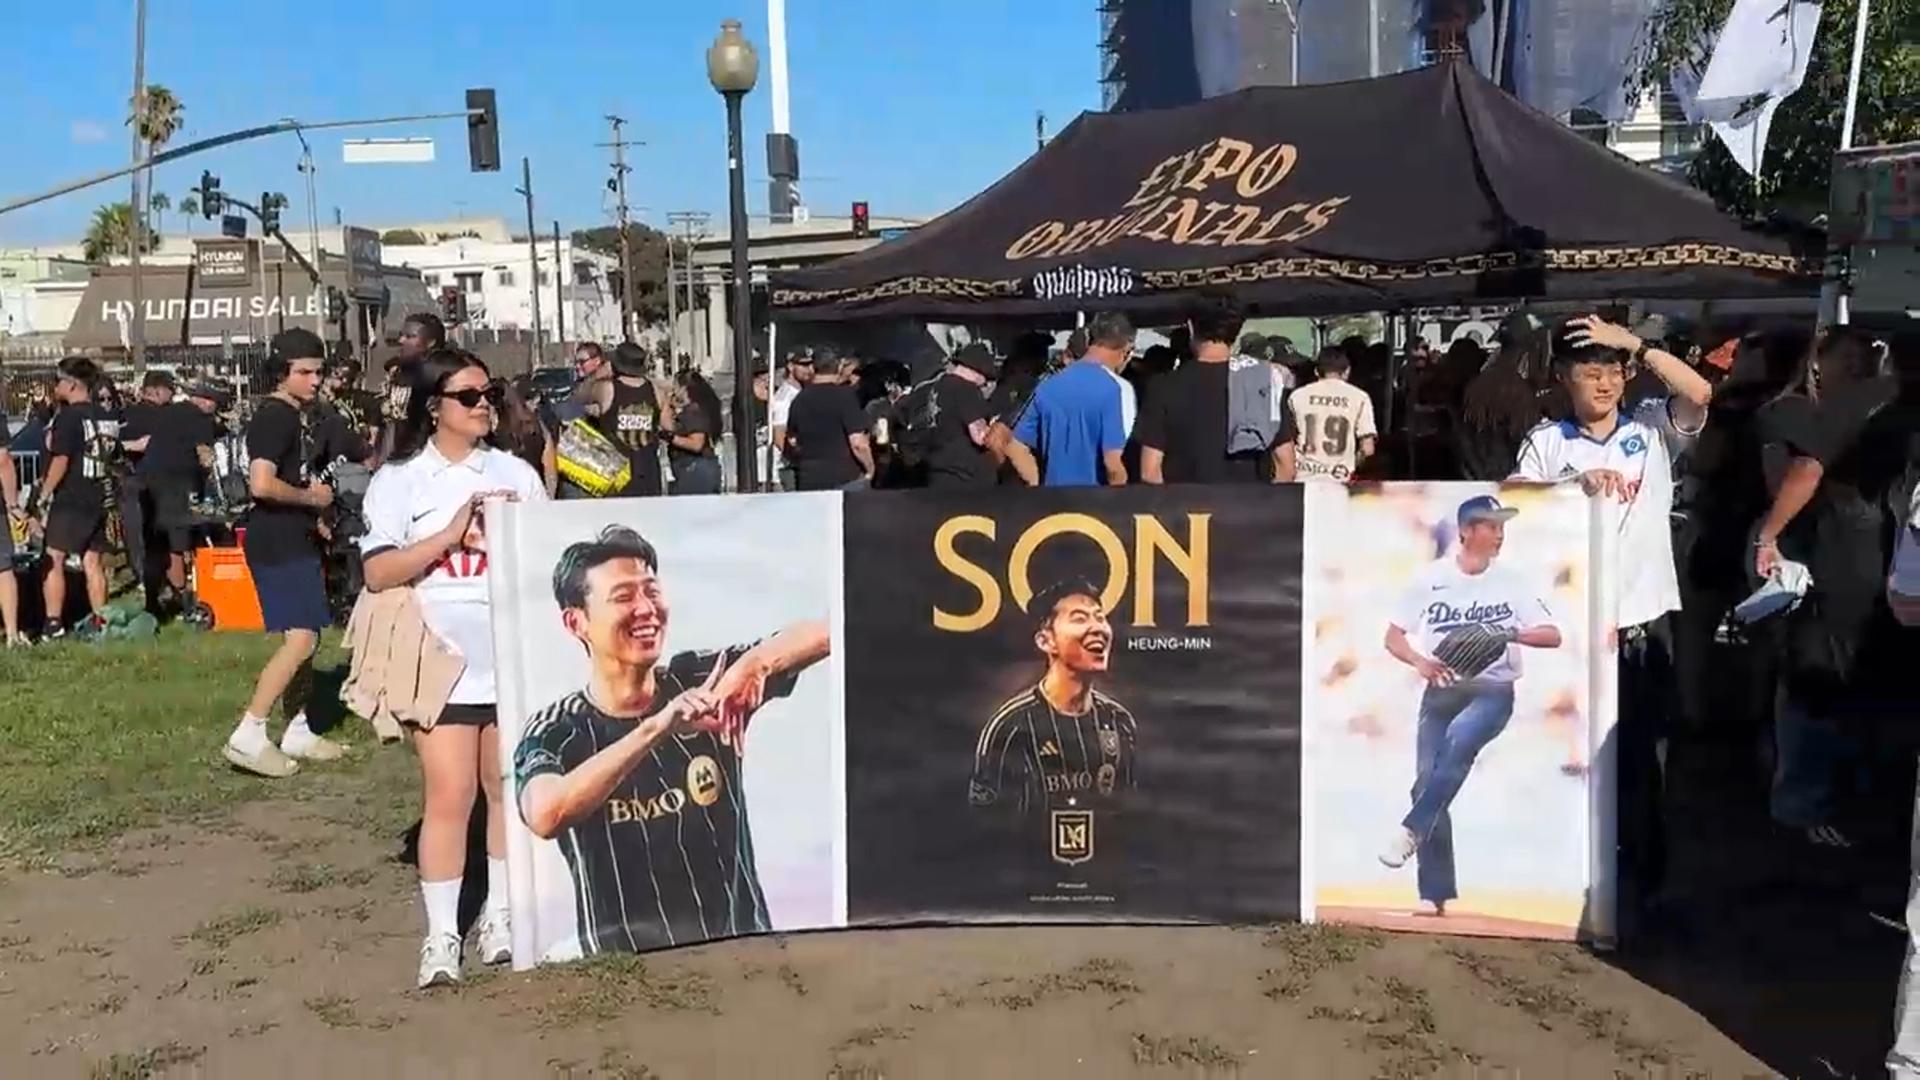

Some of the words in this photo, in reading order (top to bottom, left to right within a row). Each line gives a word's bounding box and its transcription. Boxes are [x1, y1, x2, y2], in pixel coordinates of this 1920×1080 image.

[1124, 137, 1297, 207] EXPO
[1309, 395, 1349, 408] EXPOS
[617, 414, 652, 430] 3252
[1304, 413, 1350, 456] 19
[933, 512, 1212, 633] SON
[1427, 600, 1513, 624] Dodgers
[1128, 636, 1211, 650] HEUNG-MIN
[1046, 771, 1093, 793] BMO
[608, 788, 686, 825] BMO
